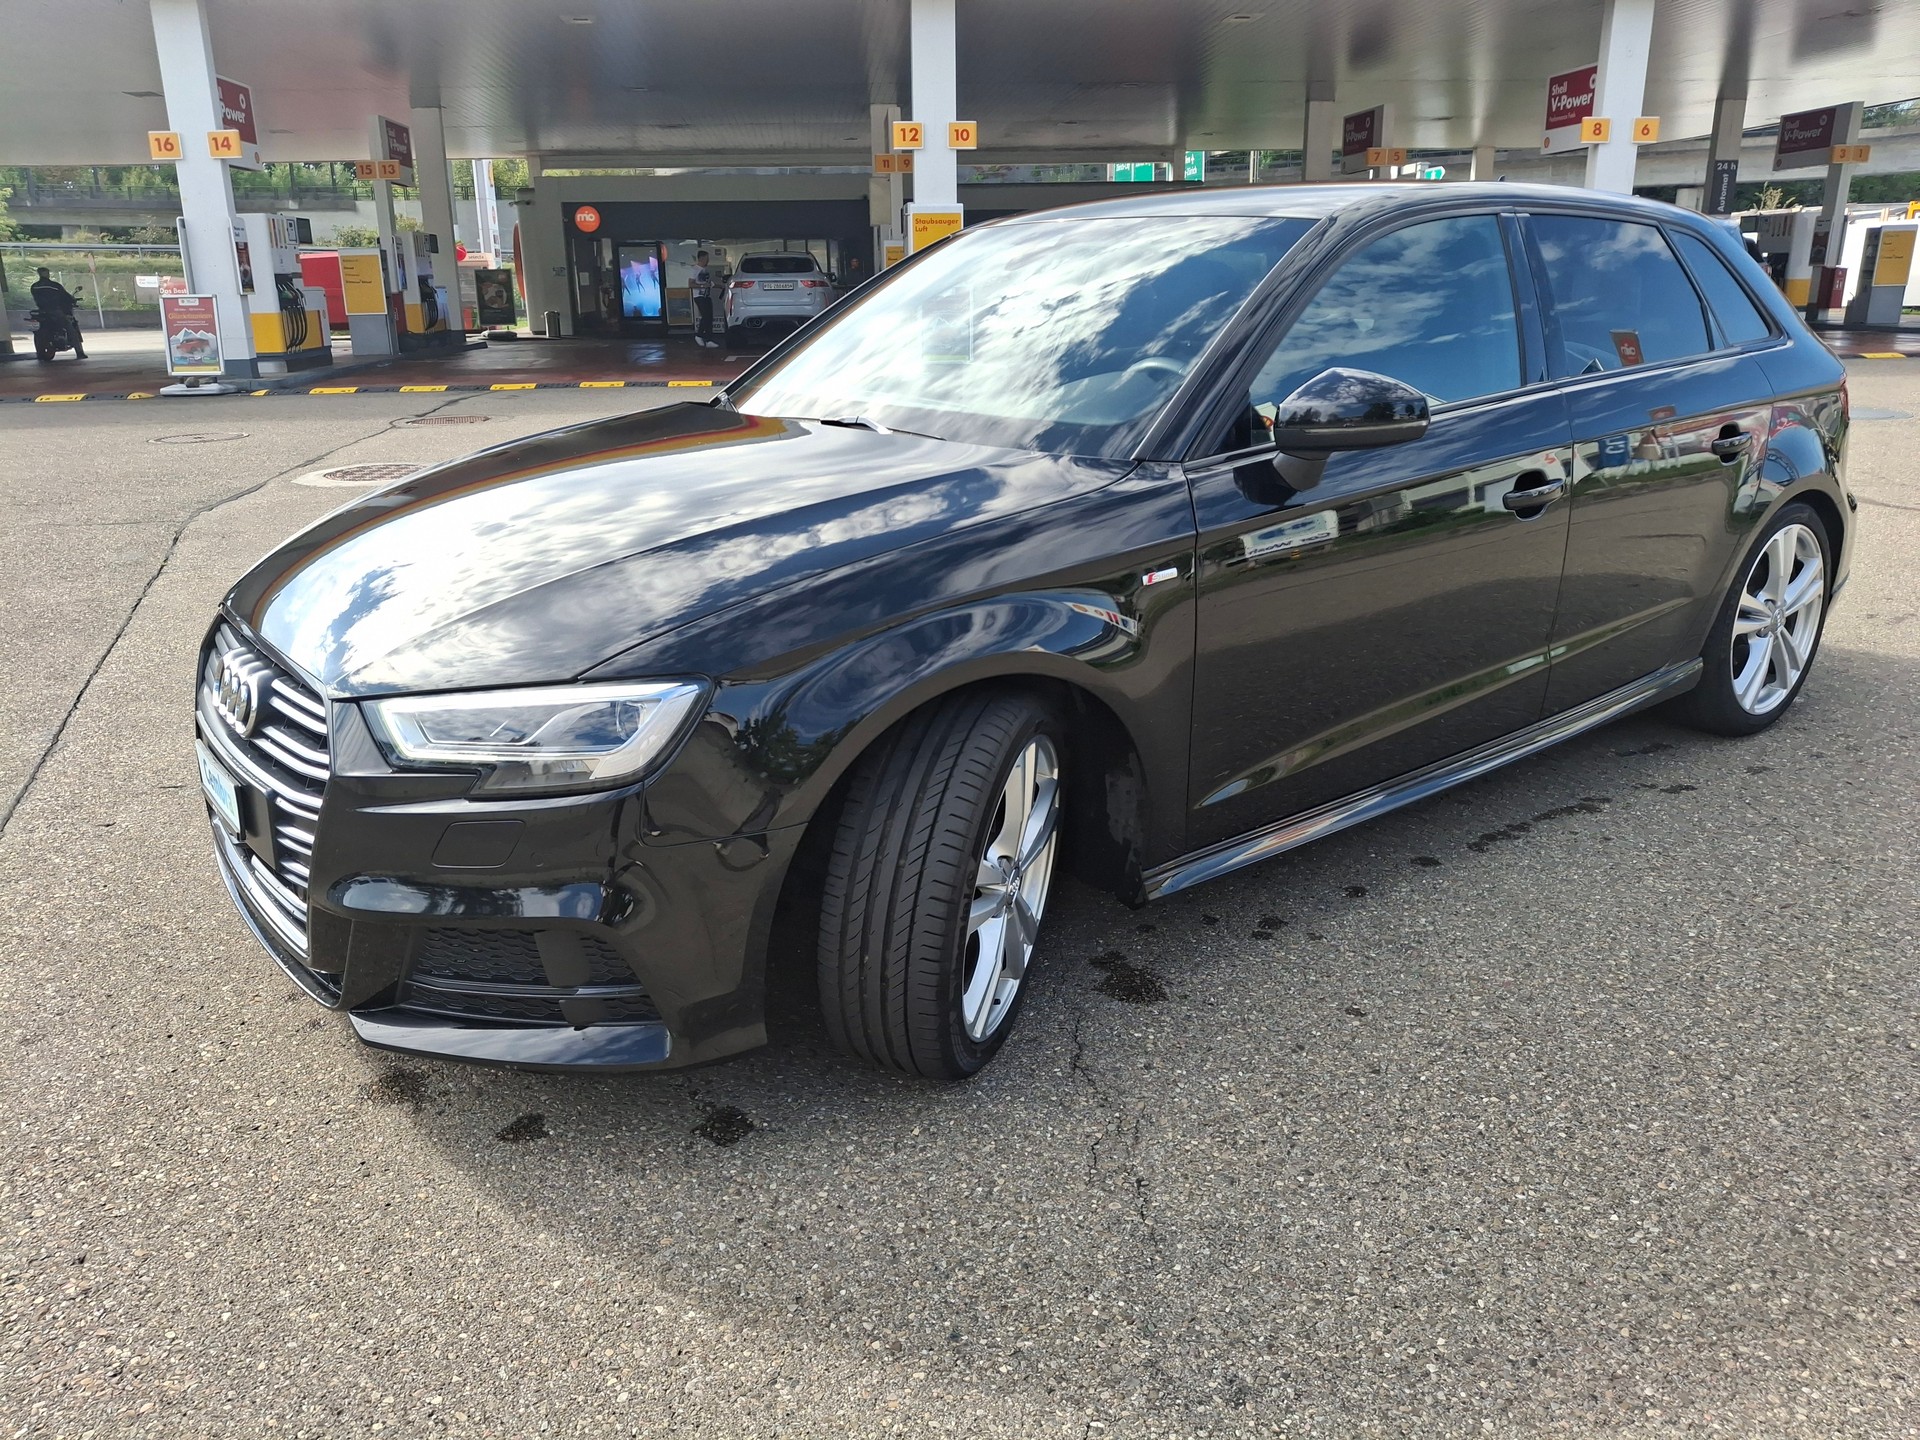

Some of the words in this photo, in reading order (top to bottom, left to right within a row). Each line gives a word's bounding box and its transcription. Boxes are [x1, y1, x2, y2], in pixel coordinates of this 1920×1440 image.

[1551, 81, 1568, 96] Shell
[1551, 92, 1593, 112] V-Power
[220, 101, 245, 123] Power
[900, 127, 919, 142] 12
[954, 128, 970, 141] 10
[1593, 122, 1602, 136] 8
[1641, 123, 1650, 136] 6
[154, 136, 175, 152] 16
[211, 136, 232, 151] 14
[1374, 152, 1381, 162] 7
[1393, 151, 1400, 161] 5
[1839, 149, 1846, 159] 3
[359, 164, 373, 175] 15
[381, 164, 396, 175] 13
[882, 159, 890, 168] 11
[903, 159, 911, 168] 9
[1717, 162, 1729, 171] 24
[1731, 162, 1737, 170] h
[1717, 174, 1729, 212] Automat
[576, 210, 596, 222] mio
[915, 217, 959, 225] Staubsauger
